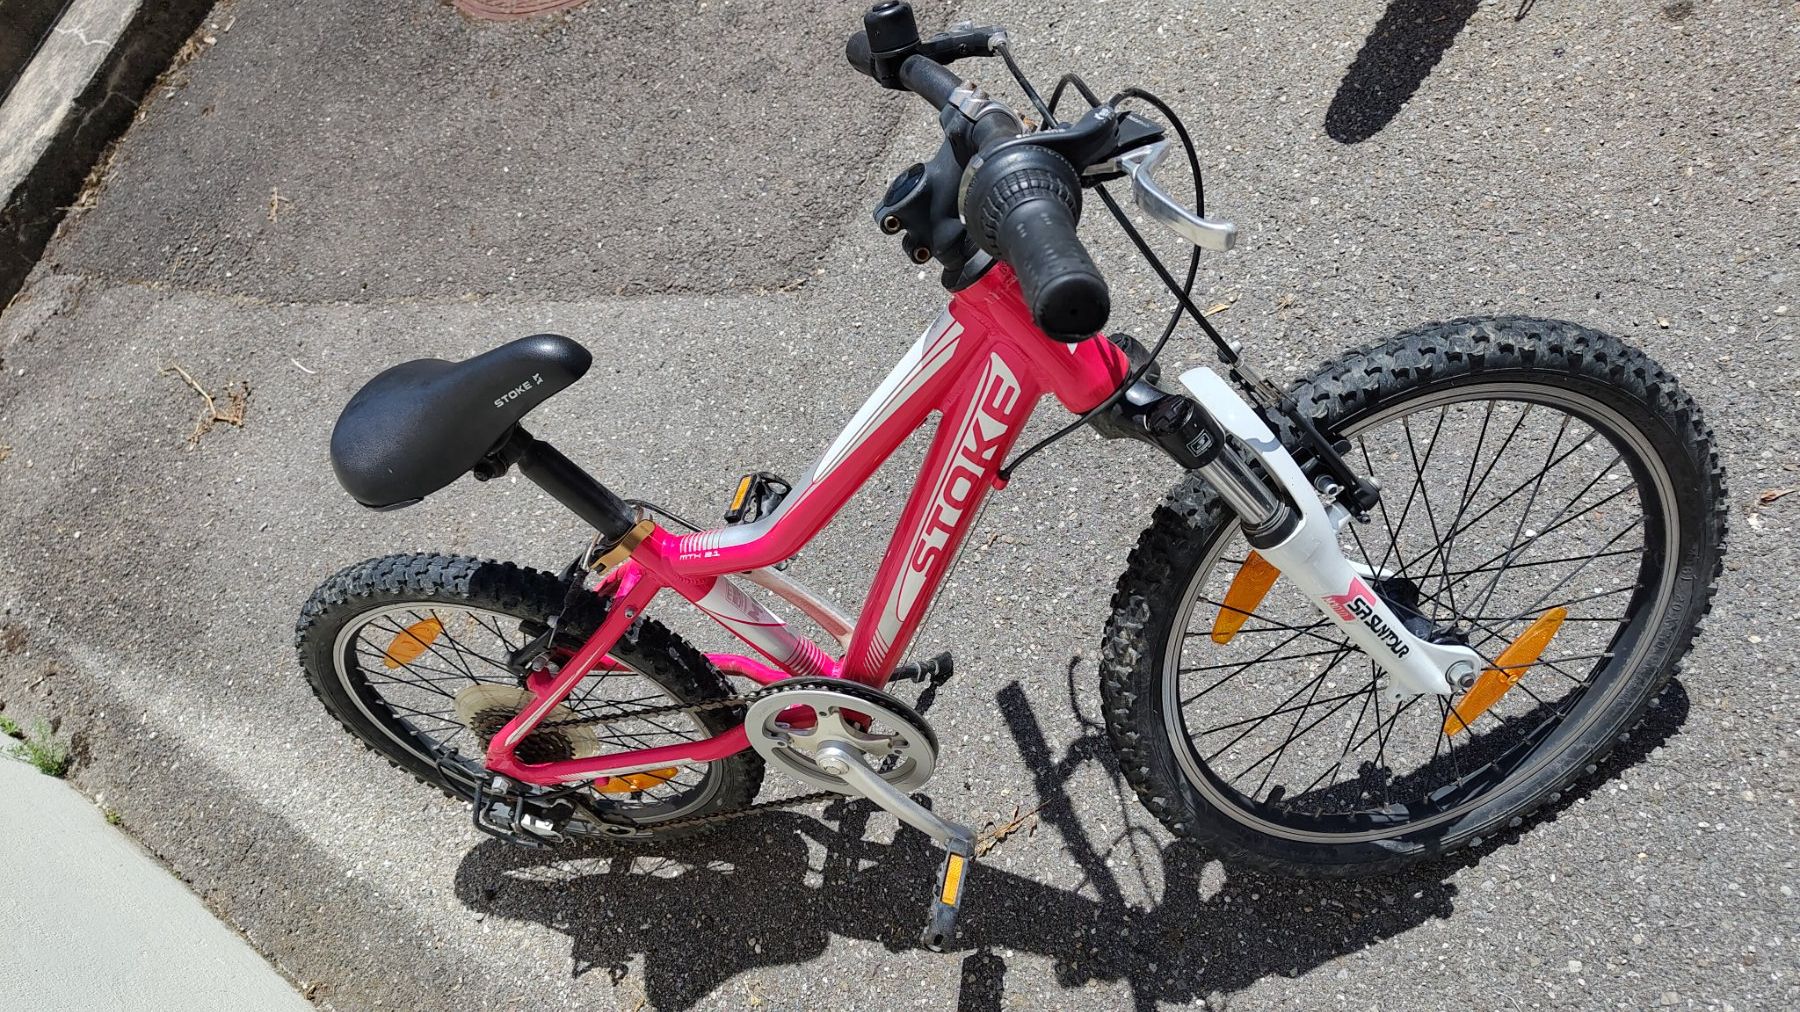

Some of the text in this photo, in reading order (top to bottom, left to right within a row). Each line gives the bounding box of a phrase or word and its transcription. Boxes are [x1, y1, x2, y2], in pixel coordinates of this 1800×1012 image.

[494, 381, 533, 408] STOKE
[912, 373, 1018, 578] STOKE
[1347, 597, 1410, 659] SR SUNTOUR
